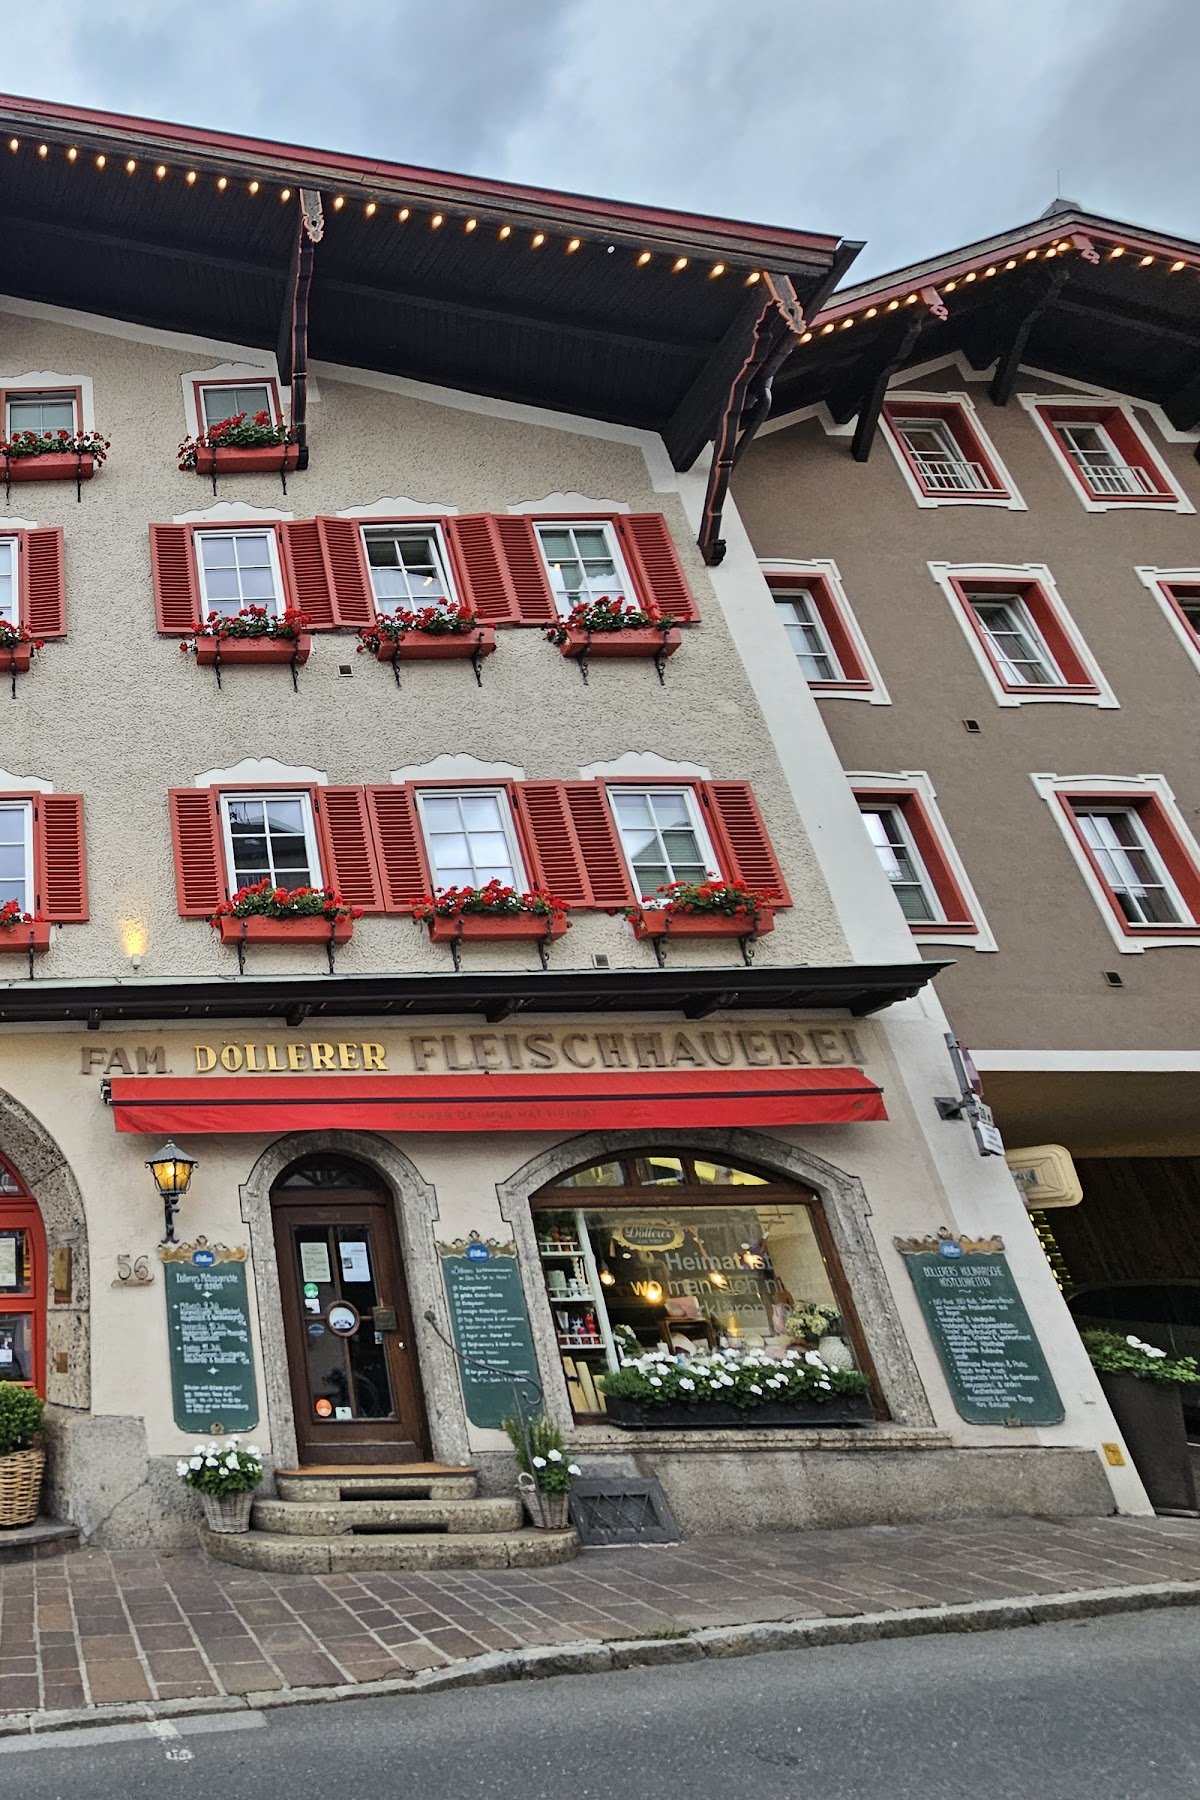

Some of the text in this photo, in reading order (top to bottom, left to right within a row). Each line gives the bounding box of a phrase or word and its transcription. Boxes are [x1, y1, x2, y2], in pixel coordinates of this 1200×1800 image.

[80, 1028, 868, 1075] FAM. DÖLLERER FLEISCHHAUEREI
[117, 1253, 149, 1280] 56
[664, 1252, 744, 1271] Heimat
[668, 1276, 712, 1296] man
